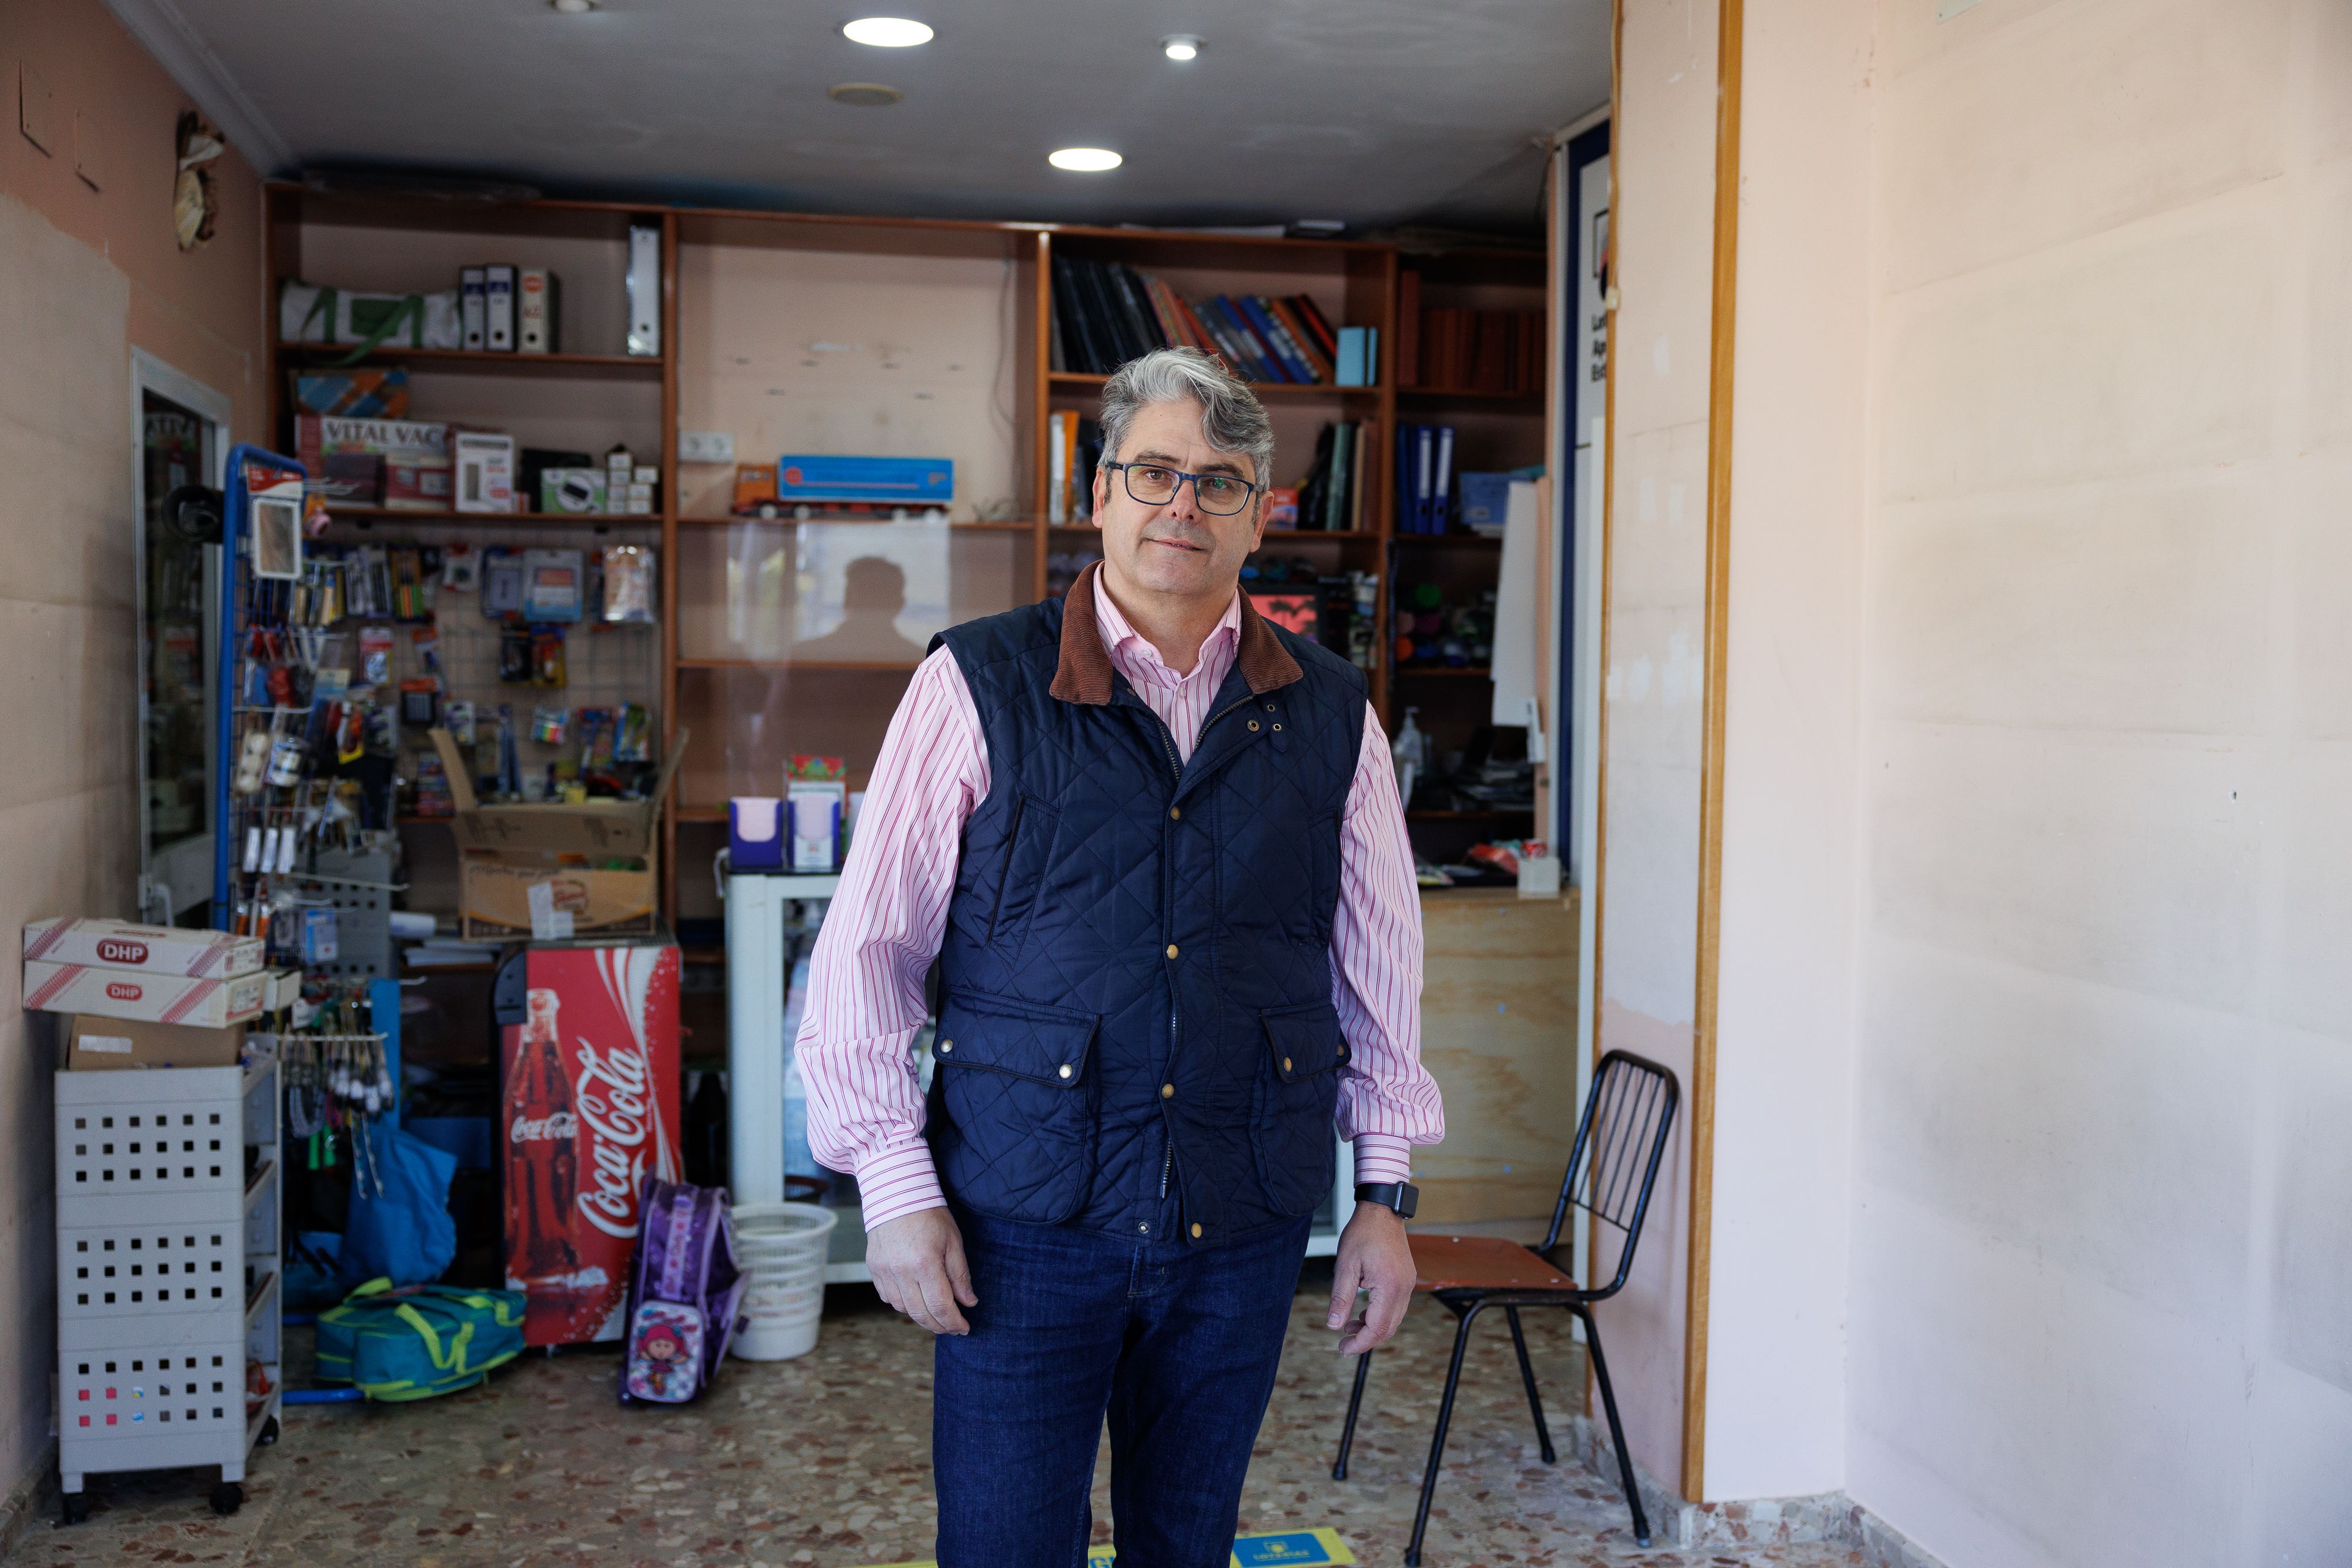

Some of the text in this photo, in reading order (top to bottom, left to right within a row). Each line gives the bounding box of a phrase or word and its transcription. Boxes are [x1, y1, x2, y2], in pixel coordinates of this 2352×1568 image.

[325, 420, 389, 444] VITAL
[104, 943, 143, 961] DHP
[111, 985, 139, 998] DHP
[576, 1035, 646, 1238] Coca-Cola
